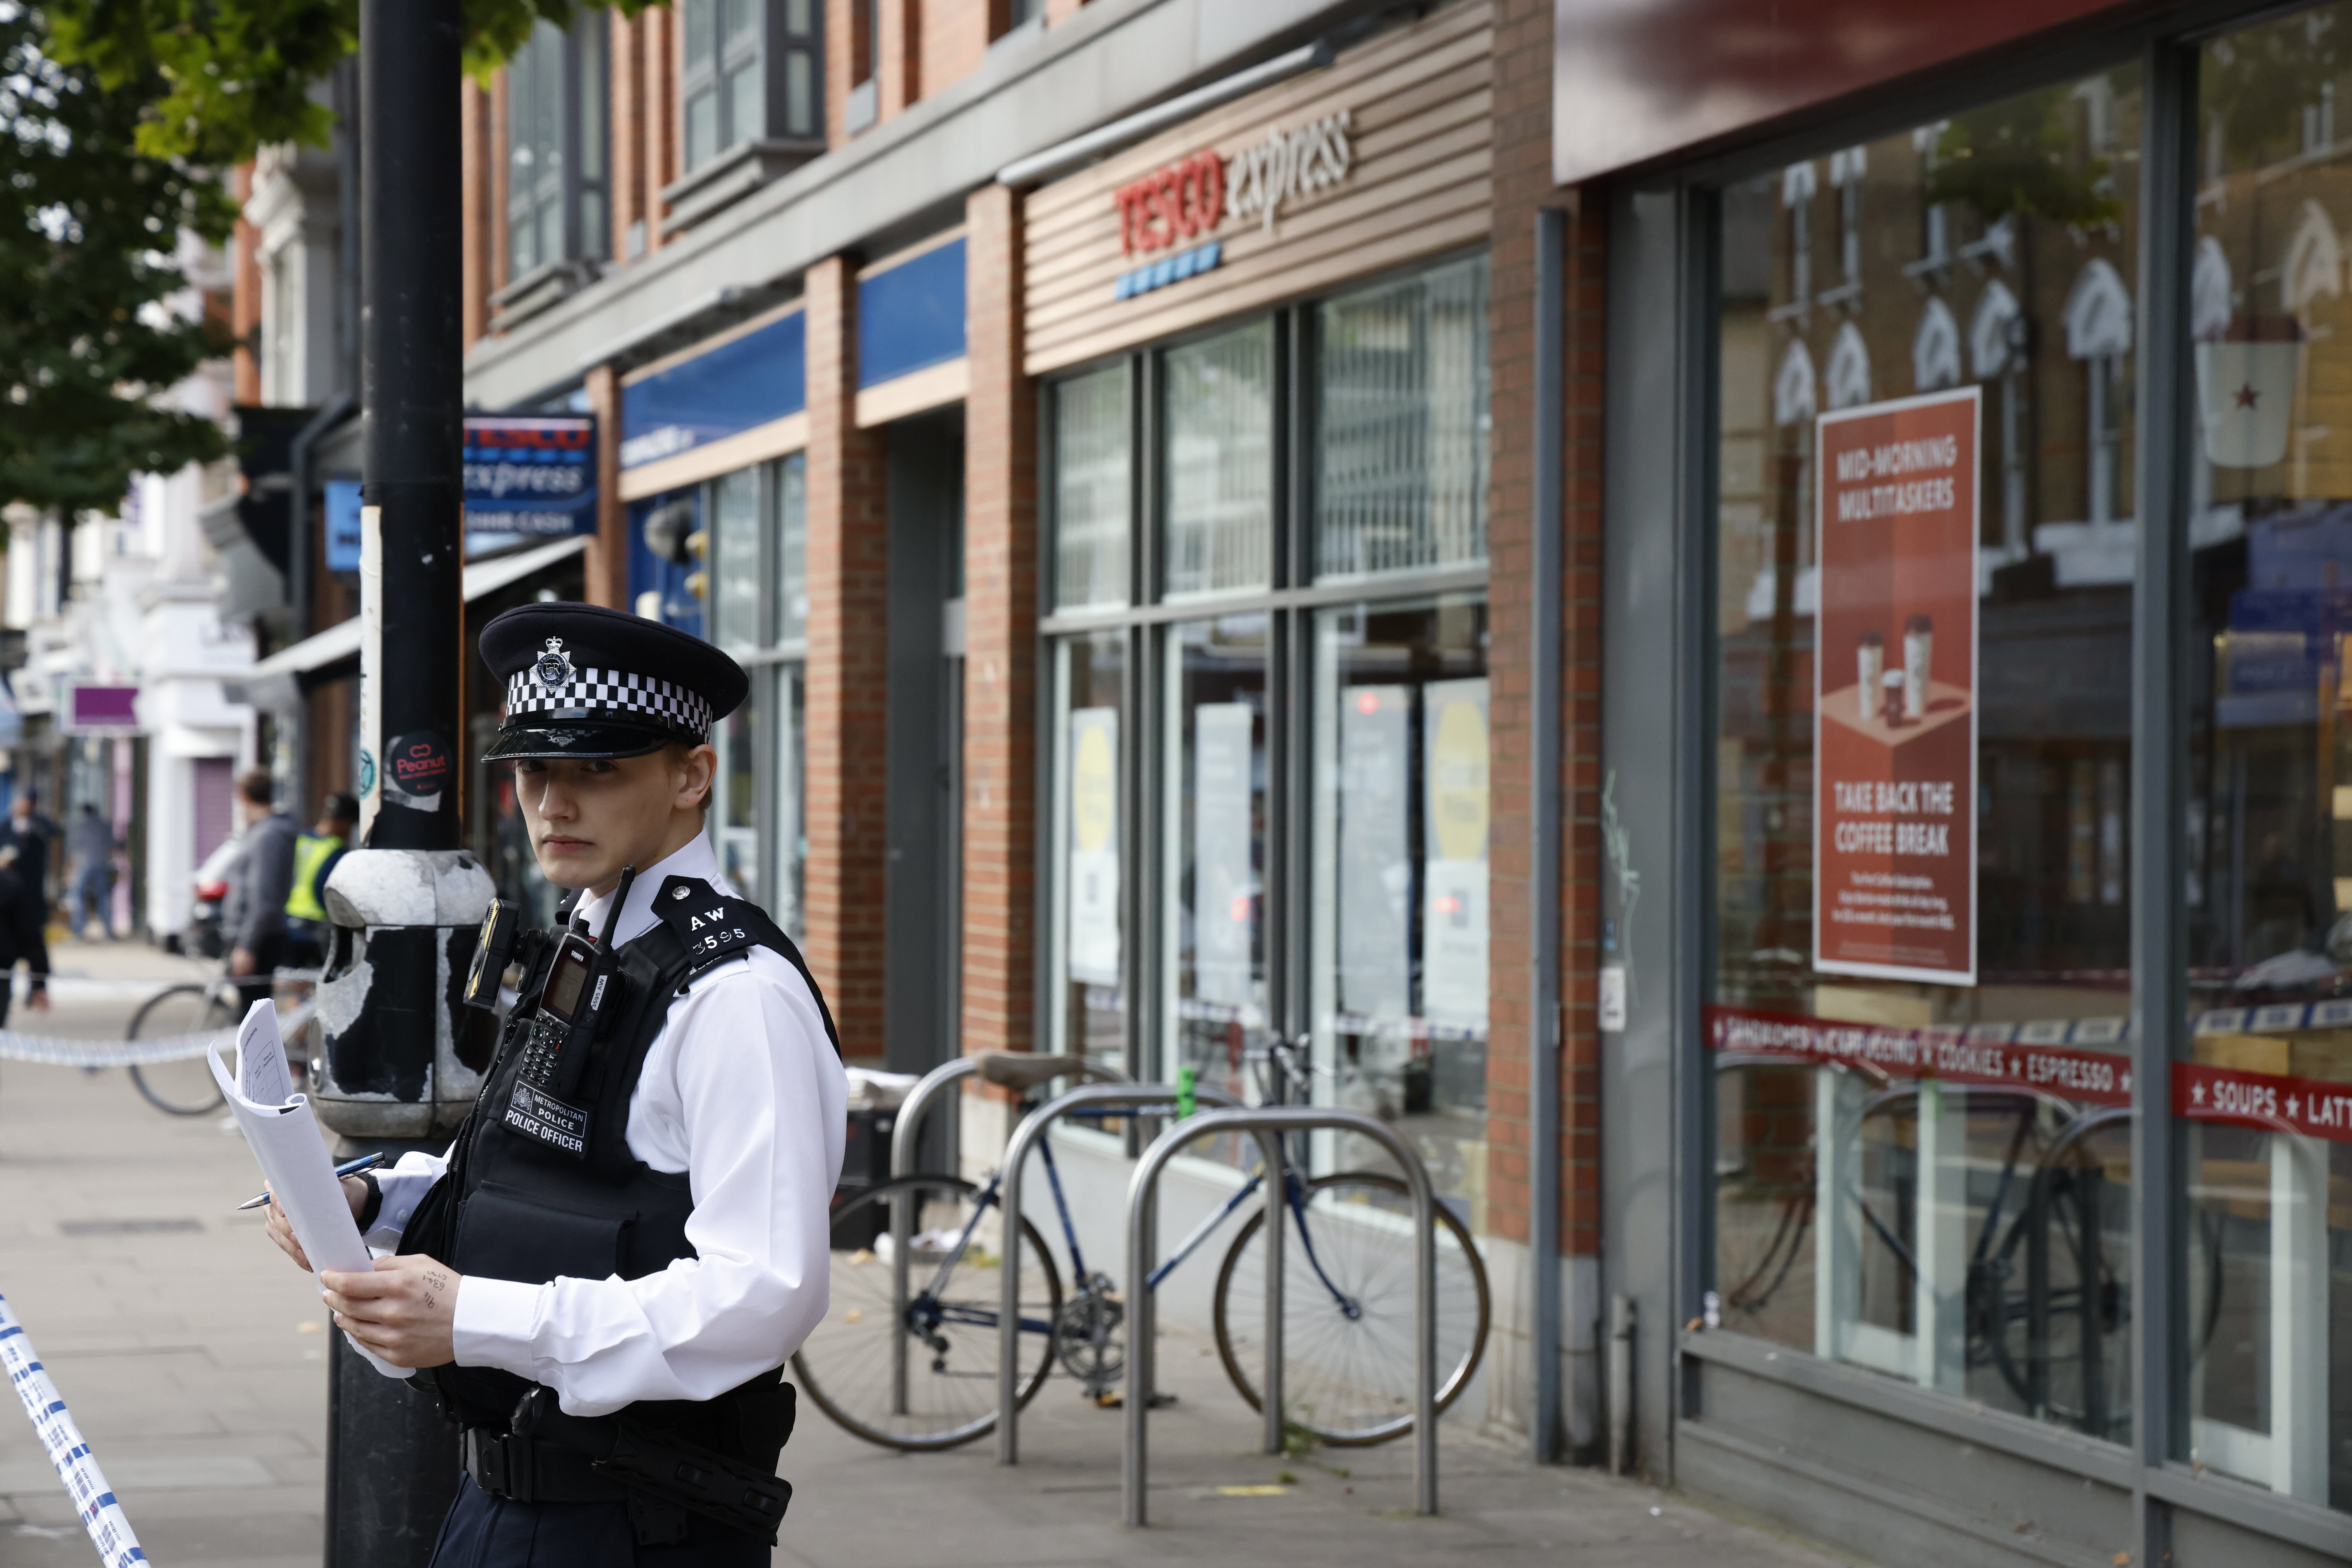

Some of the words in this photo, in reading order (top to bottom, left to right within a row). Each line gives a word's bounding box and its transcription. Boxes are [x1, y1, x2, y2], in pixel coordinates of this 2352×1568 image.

[1115, 149, 1223, 257] TESCO
[1227, 108, 1351, 233] express
[1836, 433, 1958, 481] MID-MORNING
[1838, 475, 1955, 522] MULTITASKERS
[397, 754, 446, 773] Peanut
[1834, 781, 1873, 813] TAKE
[1876, 782, 1917, 814] BACK
[1920, 782, 1954, 815] THE
[1834, 821, 1893, 854] COFFEE
[1896, 822, 1949, 857] BREAK
[571, 950, 584, 961] sepura
[692, 928, 746, 955] 3595
[592, 993, 600, 1008] 3595
[598, 978, 604, 991] AW
[245, 1027, 258, 1047] columns
[1937, 1044, 2003, 1077] COOKIES
[2027, 1053, 2113, 1093] ESPRESSO
[2213, 1080, 2277, 1117] SOUPS
[534, 1094, 584, 1122] METROPOLITAN
[538, 1108, 574, 1130] POLICE
[505, 1109, 540, 1135] POLICE
[541, 1126, 583, 1153] OFFICER
